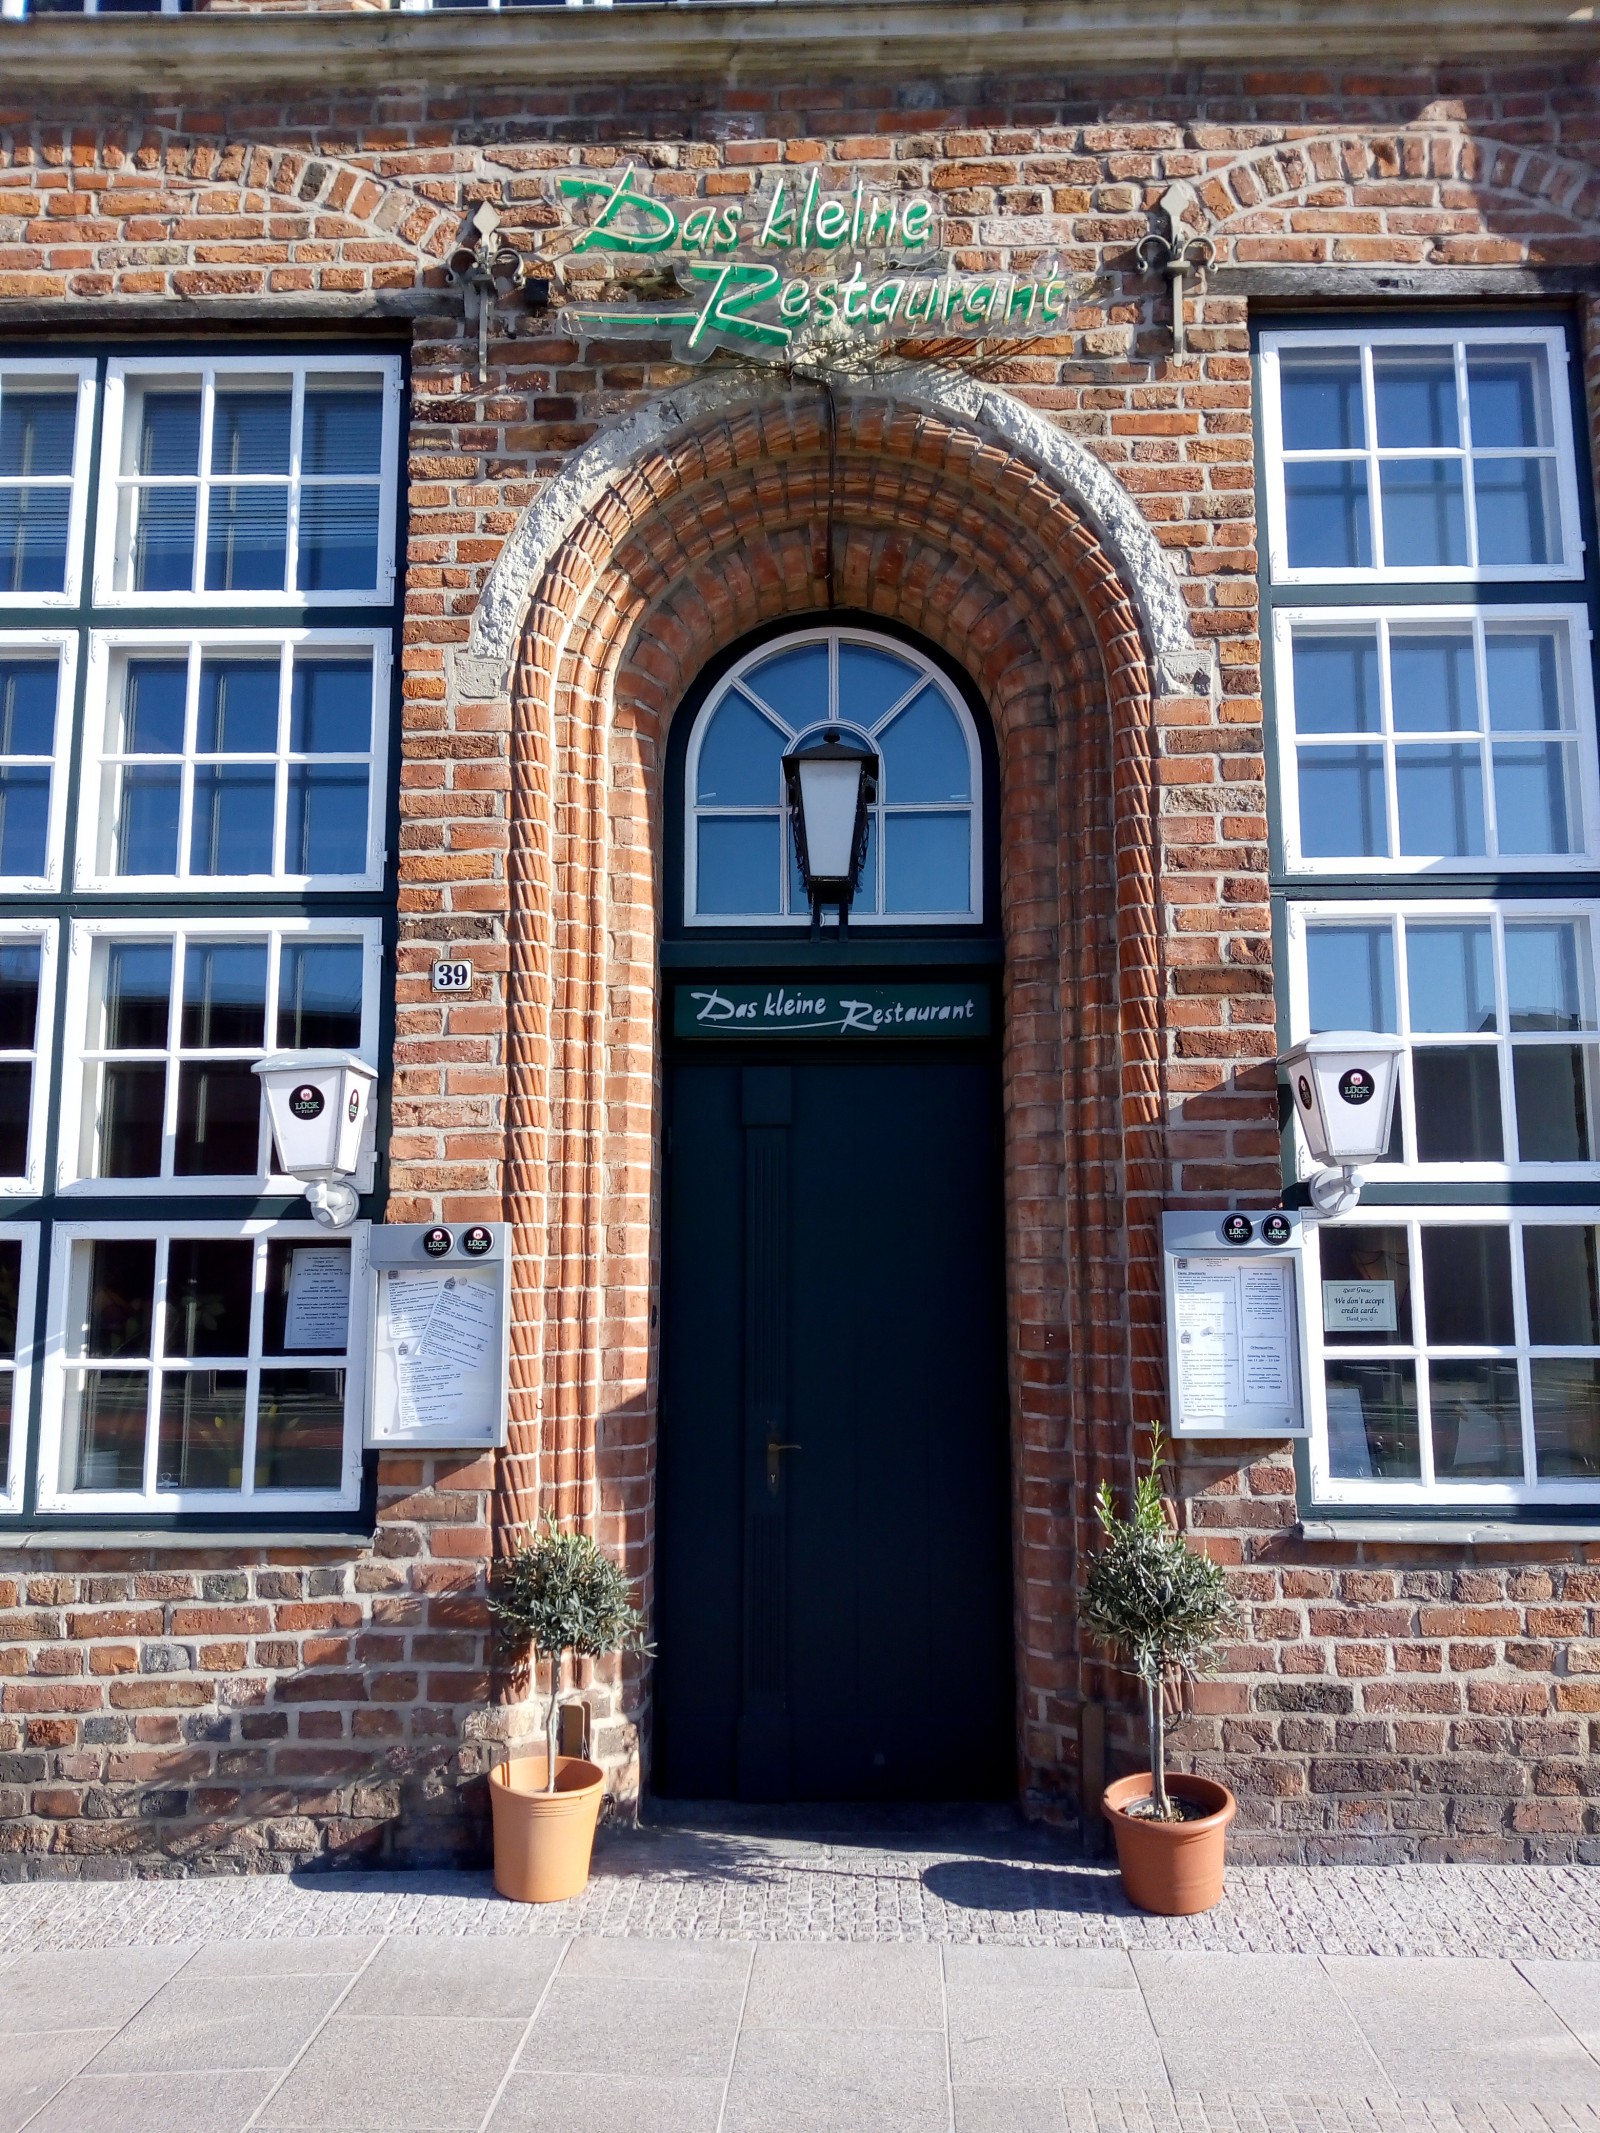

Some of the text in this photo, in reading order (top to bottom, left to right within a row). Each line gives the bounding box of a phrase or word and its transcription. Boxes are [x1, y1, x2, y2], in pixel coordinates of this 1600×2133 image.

[556, 161, 933, 253] Das kleine
[687, 260, 1068, 348] Restaurant
[438, 964, 468, 986] 39
[690, 988, 974, 1033] Das kleine Restaurant
[1334, 1296, 1385, 1306] We don't accept
[1341, 1306, 1379, 1314] credit cards.
